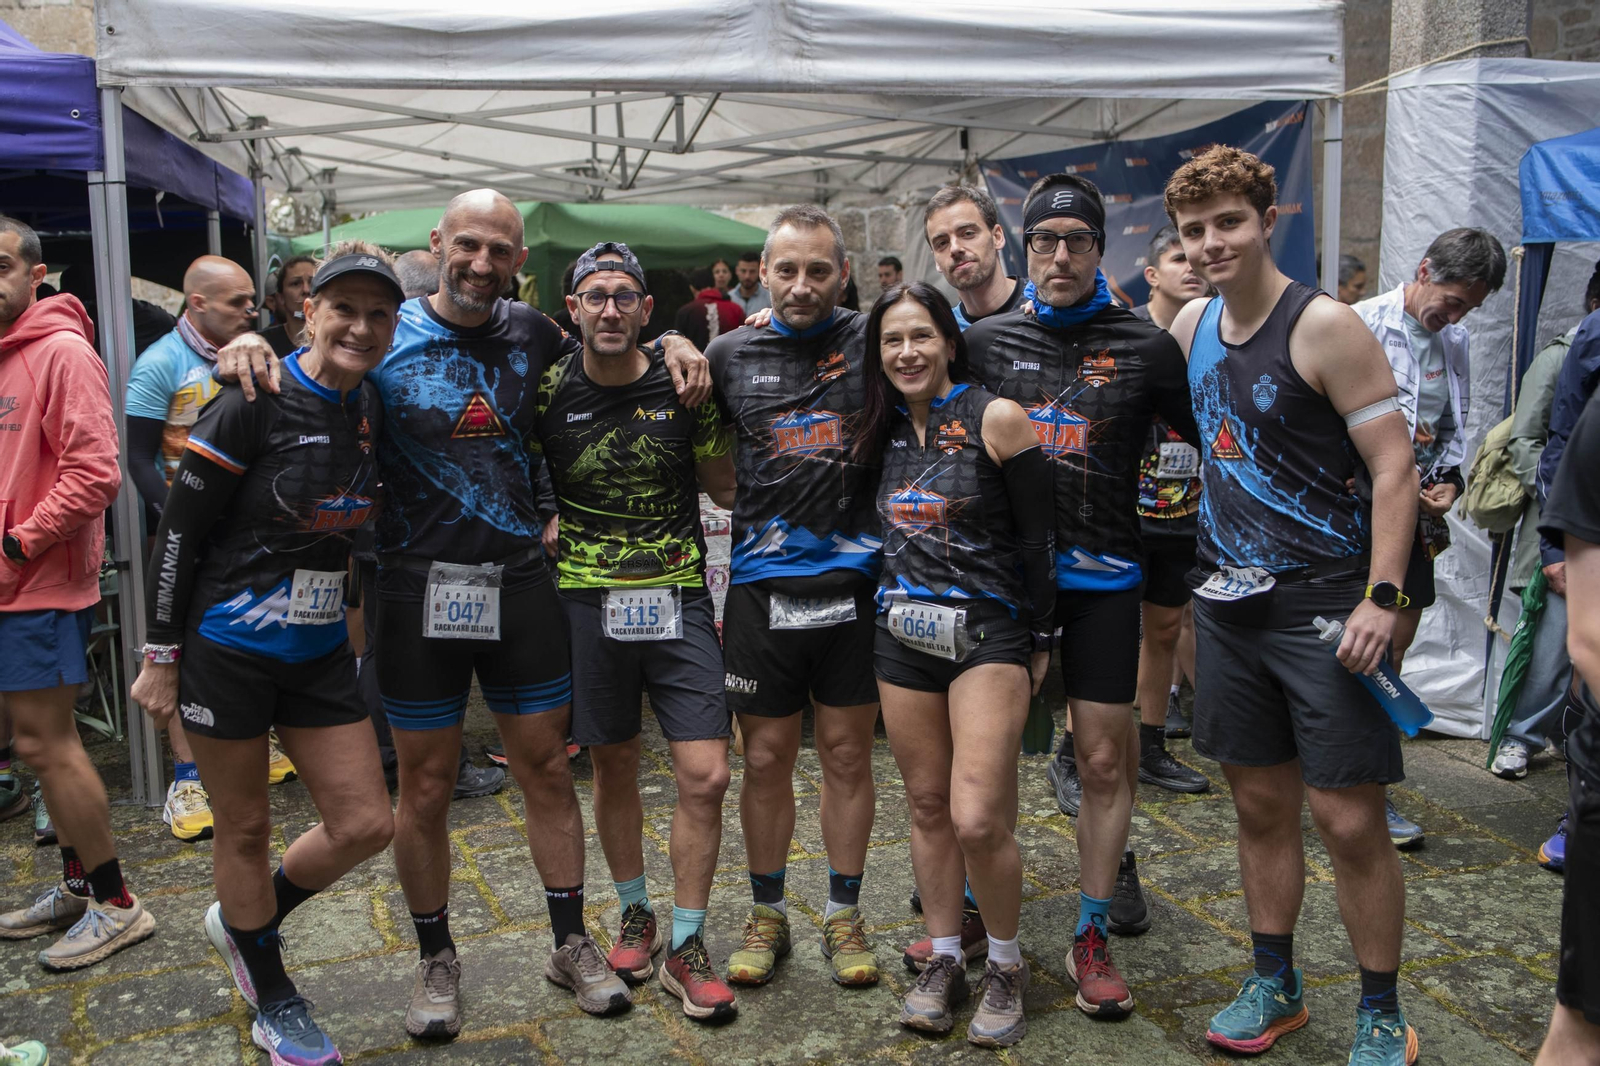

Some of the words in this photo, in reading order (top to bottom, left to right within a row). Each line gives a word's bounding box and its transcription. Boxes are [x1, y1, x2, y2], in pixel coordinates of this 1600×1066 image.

[156, 528, 183, 623] RUNMANIAK
[445, 591, 488, 602] SPAIN
[619, 596, 662, 605] SPAIN
[447, 600, 486, 624] 047
[623, 605, 660, 627] 115
[901, 608, 943, 622] SPAIN
[434, 622, 470, 633] BACKYARD
[471, 624, 496, 634] ULTRA
[610, 626, 645, 636] BACKYARD
[903, 616, 938, 641] 064
[262, 1020, 282, 1050] HOKA
